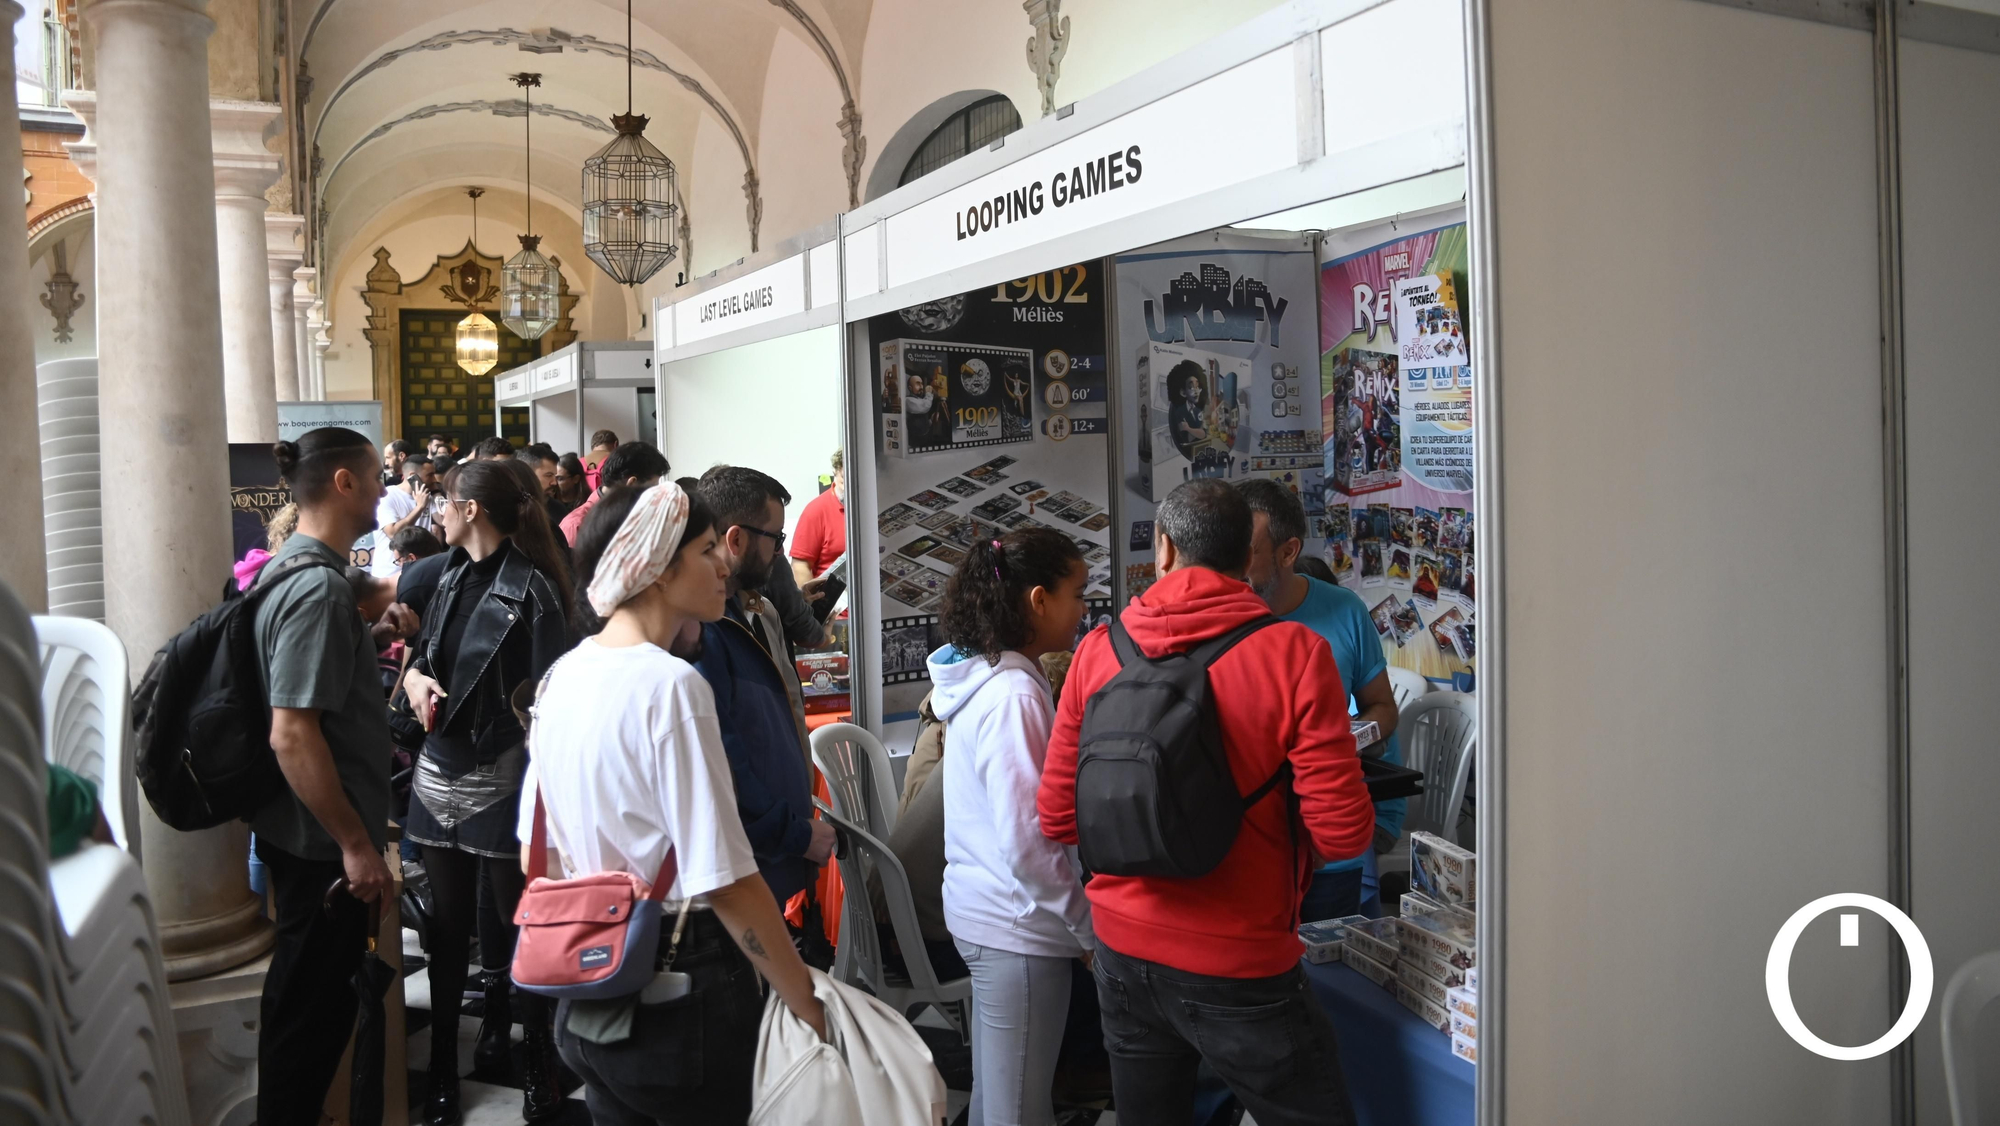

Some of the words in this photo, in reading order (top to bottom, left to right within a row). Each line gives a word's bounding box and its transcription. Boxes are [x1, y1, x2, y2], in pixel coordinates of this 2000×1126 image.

[956, 180, 1044, 242] LOOPING
[1051, 144, 1143, 208] GAMES
[1384, 252, 1410, 272] MARVEL
[700, 302, 717, 324] LAST
[719, 295, 742, 319] LEVEL
[743, 285, 773, 312] GAMES
[1143, 263, 1288, 348] URBIFY
[1409, 291, 1438, 307] TORNEO!
[1012, 306, 1064, 323] Méliès
[1070, 356, 1092, 369] 2-4
[955, 406, 998, 429] 1902
[1072, 419, 1095, 432] 12+
[966, 427, 989, 438] Méliès
[1443, 855, 1462, 875] 1980
[1432, 938, 1452, 955] 1980
[1430, 960, 1447, 977] 1980
[1429, 982, 1446, 999] 1980
[1426, 1005, 1442, 1023] 1980
